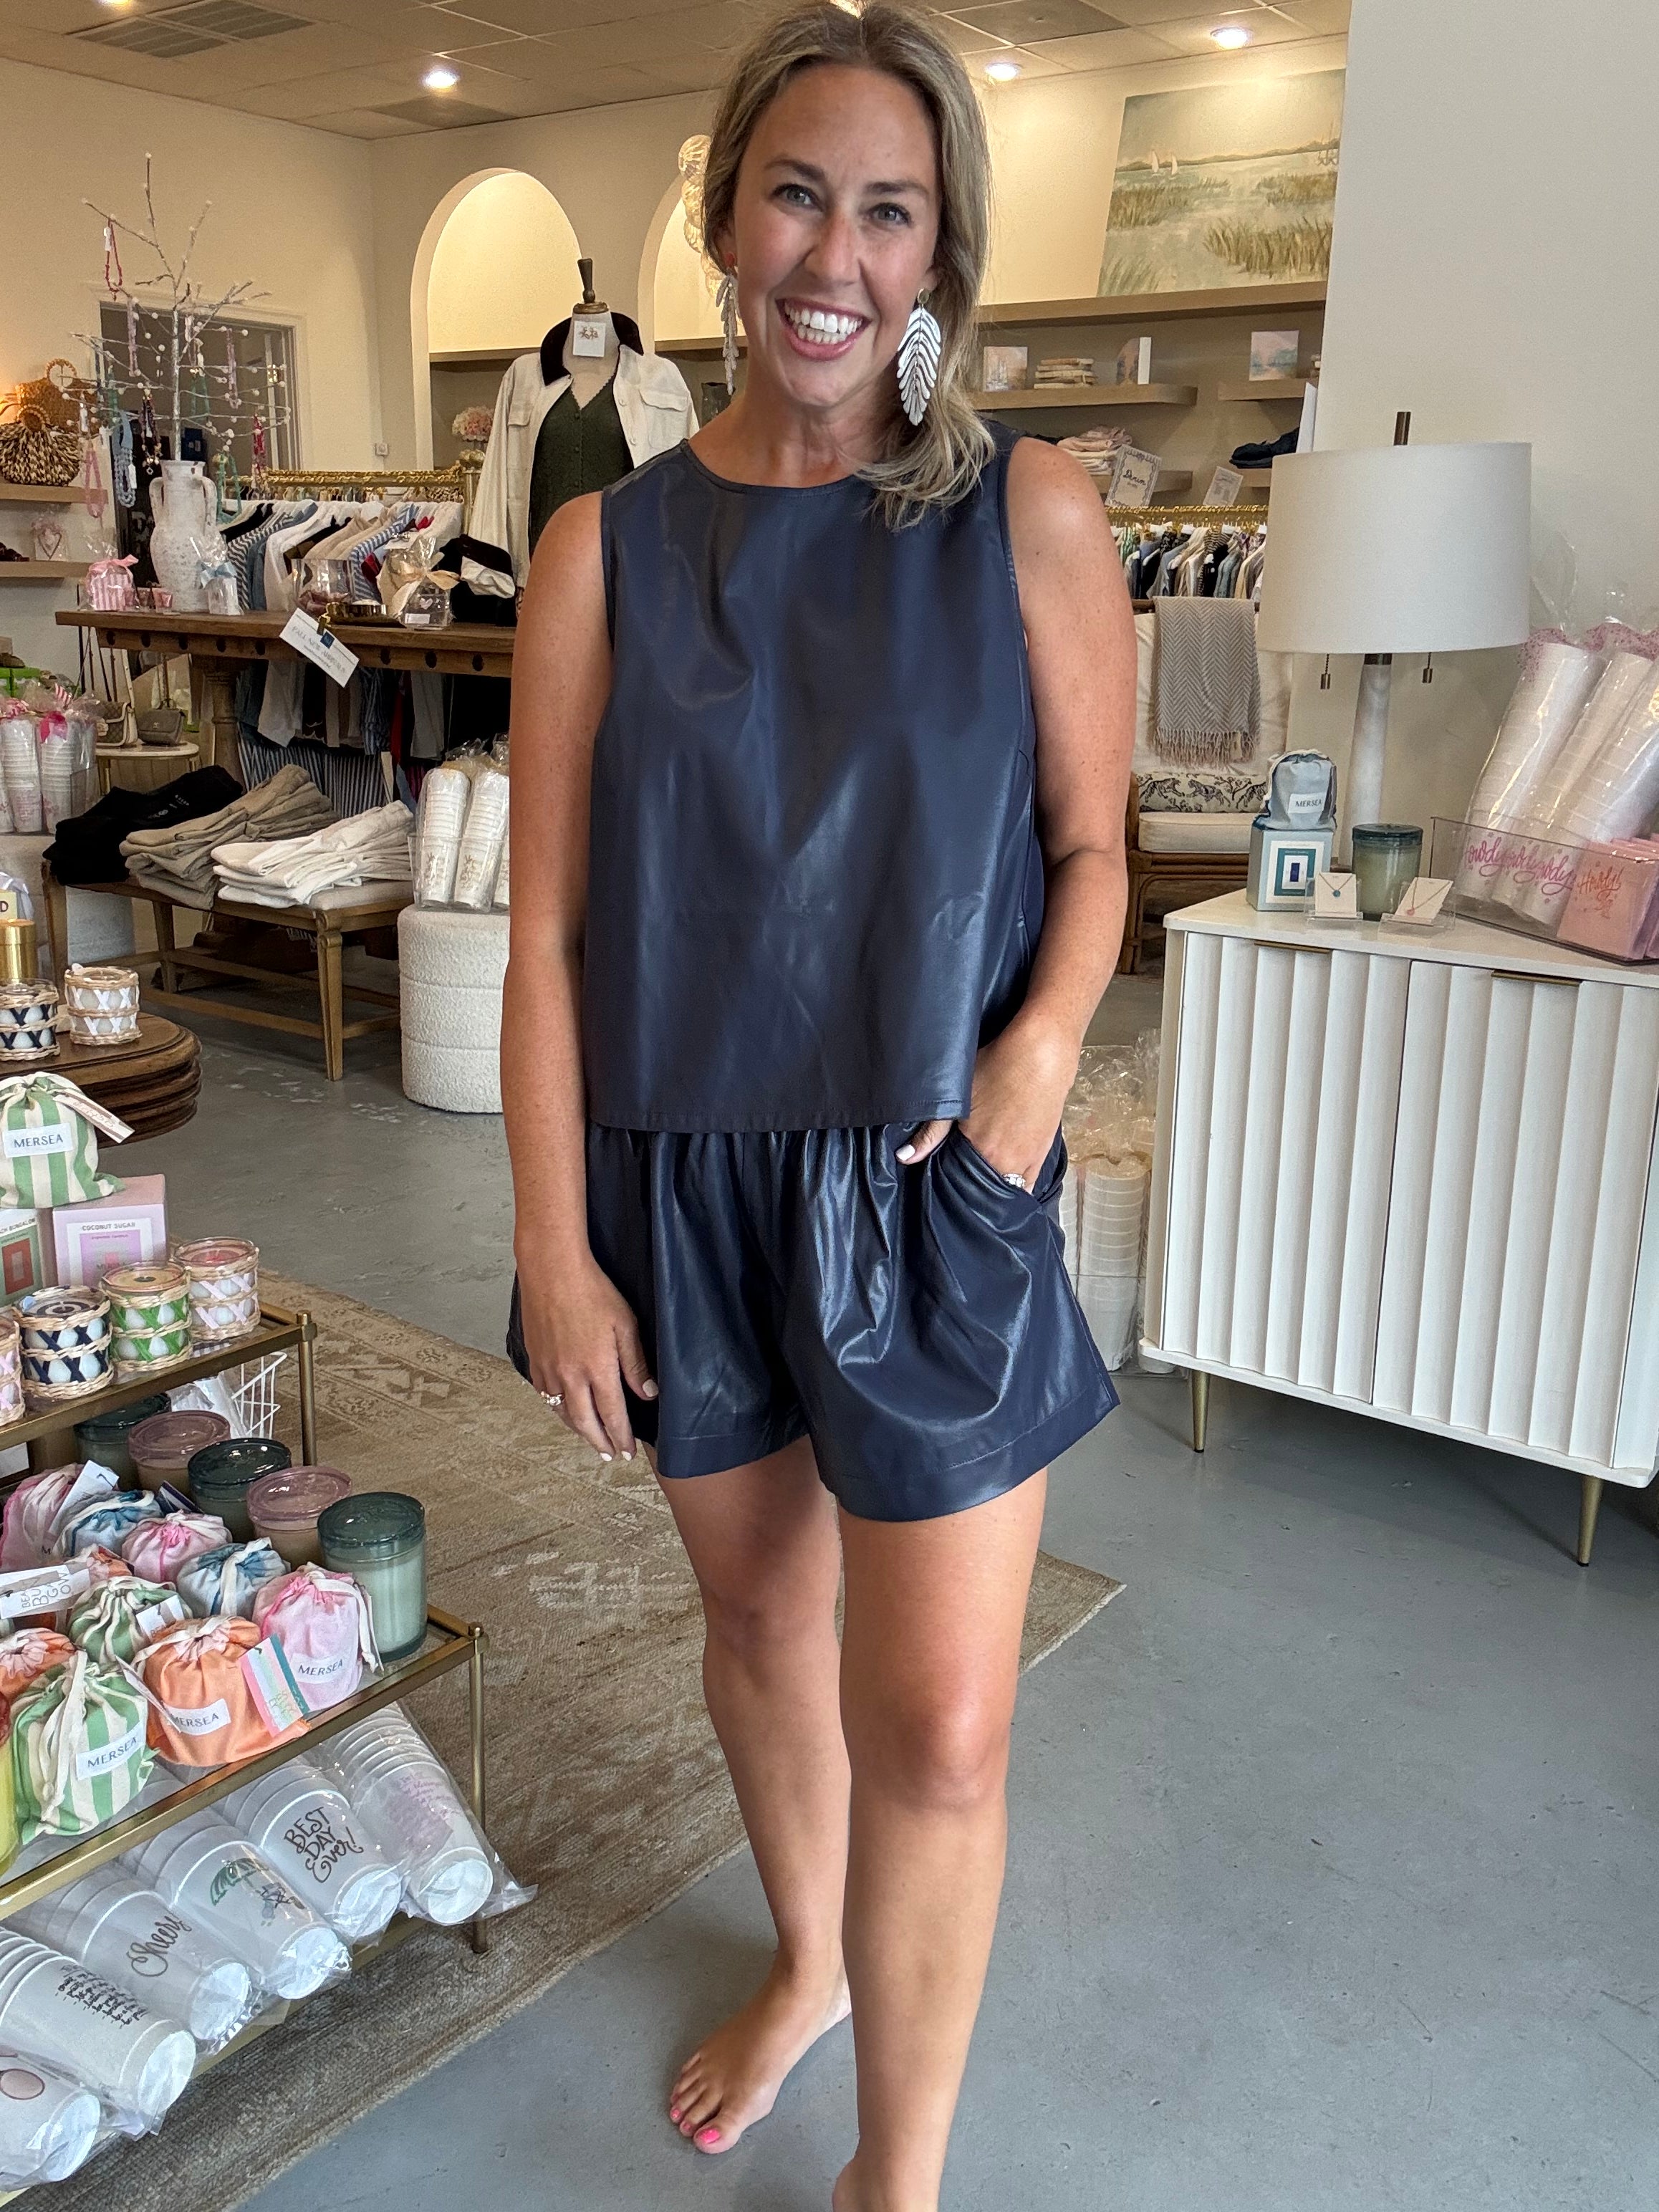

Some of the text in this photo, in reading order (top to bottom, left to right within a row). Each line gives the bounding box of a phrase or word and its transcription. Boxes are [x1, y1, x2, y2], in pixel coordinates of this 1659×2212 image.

[1295, 799, 1322, 807] MERSEA
[14, 1134, 64, 1148] MERSEA
[298, 1659, 343, 1676] MERSEA
[87, 1736, 138, 1768] MERSEA
[284, 1807, 330, 1854] BEST
[304, 1826, 336, 1861] DAY
